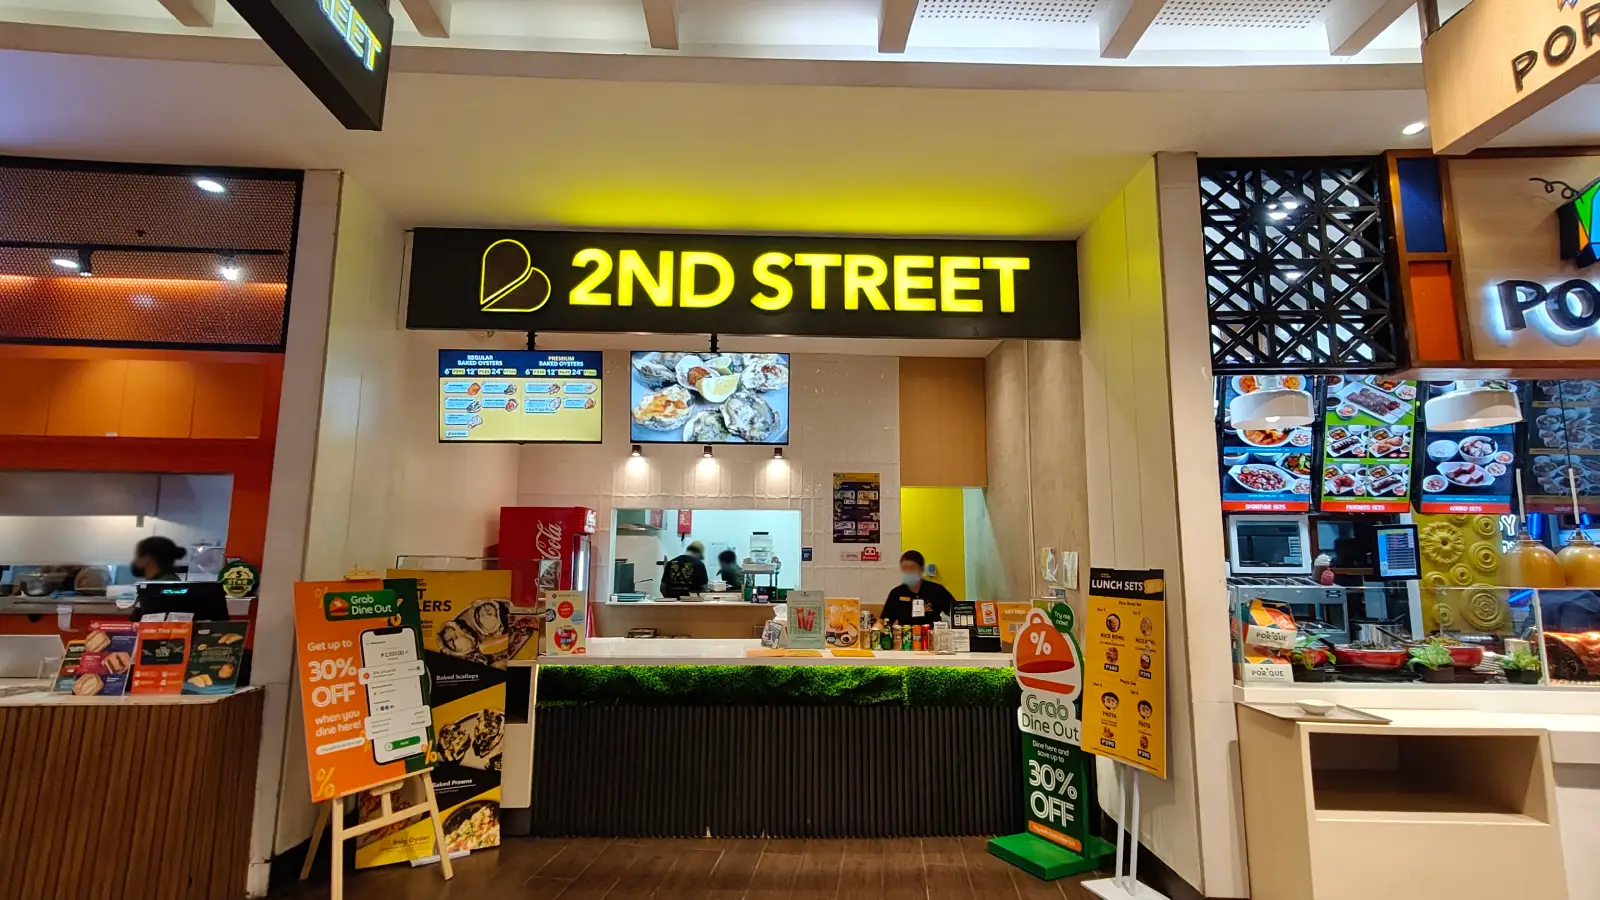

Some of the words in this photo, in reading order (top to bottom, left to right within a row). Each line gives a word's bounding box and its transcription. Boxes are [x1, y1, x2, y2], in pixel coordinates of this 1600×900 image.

[569, 248, 735, 307] 2ND
[750, 251, 1031, 313] STREET
[1092, 580, 1122, 590] LUNCH
[1124, 582, 1143, 591] SETS
[350, 594, 374, 604] Grab
[352, 605, 374, 615] Dine
[374, 604, 392, 614] Out
[1054, 610, 1062, 619] Try
[308, 642, 326, 652] Get
[328, 642, 340, 652] up
[308, 657, 357, 682] 30%
[312, 682, 356, 708] OFF
[1026, 694, 1068, 720] Grab
[315, 714, 341, 725] when
[342, 710, 360, 722] you
[316, 724, 337, 736] dine
[338, 720, 362, 732] here!
[1022, 713, 1050, 734] Dine
[1054, 722, 1079, 742] Out
[1032, 740, 1044, 749] Dine
[1044, 743, 1057, 752] here
[1058, 748, 1069, 756] and
[1038, 750, 1050, 759] save
[1050, 754, 1058, 762] up
[1028, 760, 1078, 800] 30%
[1030, 791, 1075, 828] OFF
